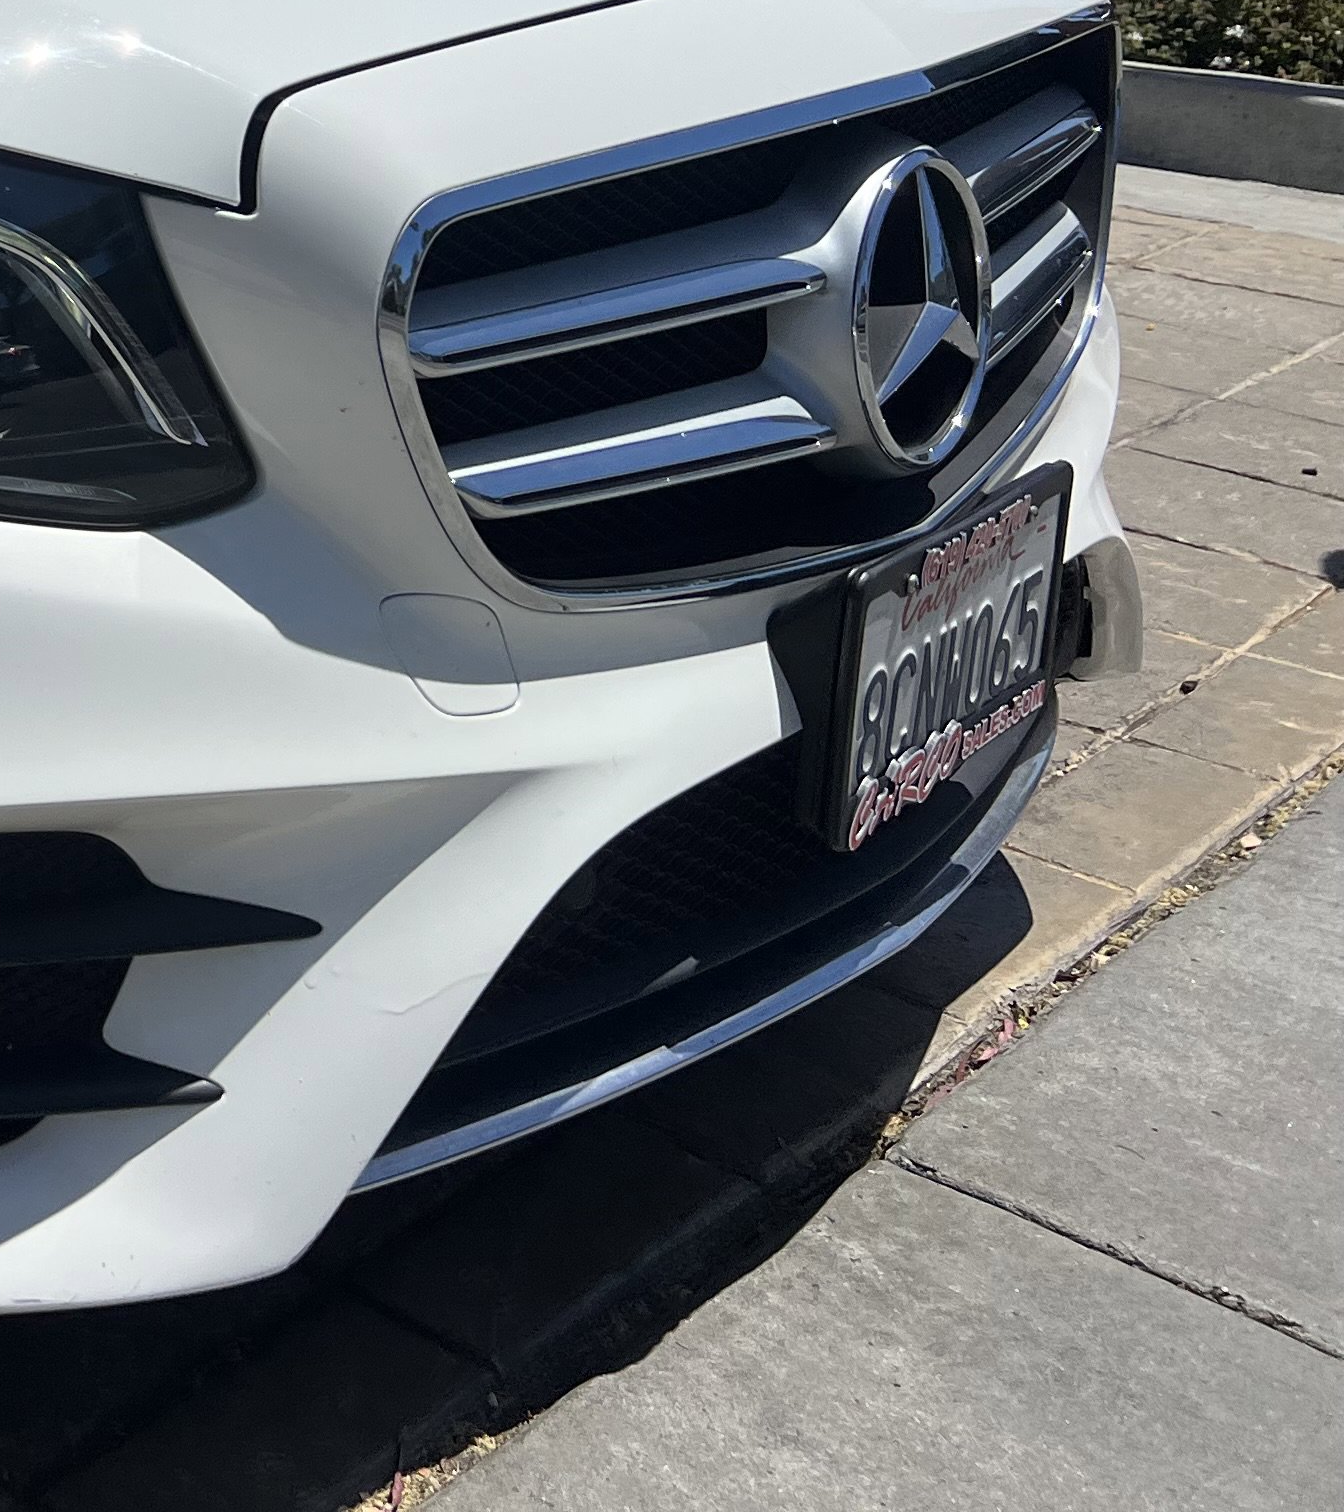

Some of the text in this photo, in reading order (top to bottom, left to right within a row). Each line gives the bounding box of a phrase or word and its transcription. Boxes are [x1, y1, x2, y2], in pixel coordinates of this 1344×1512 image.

[902, 534, 1028, 632] California
[856, 565, 1045, 786] 8CNW065
[848, 678, 1047, 852] CARCO SALES.COM
